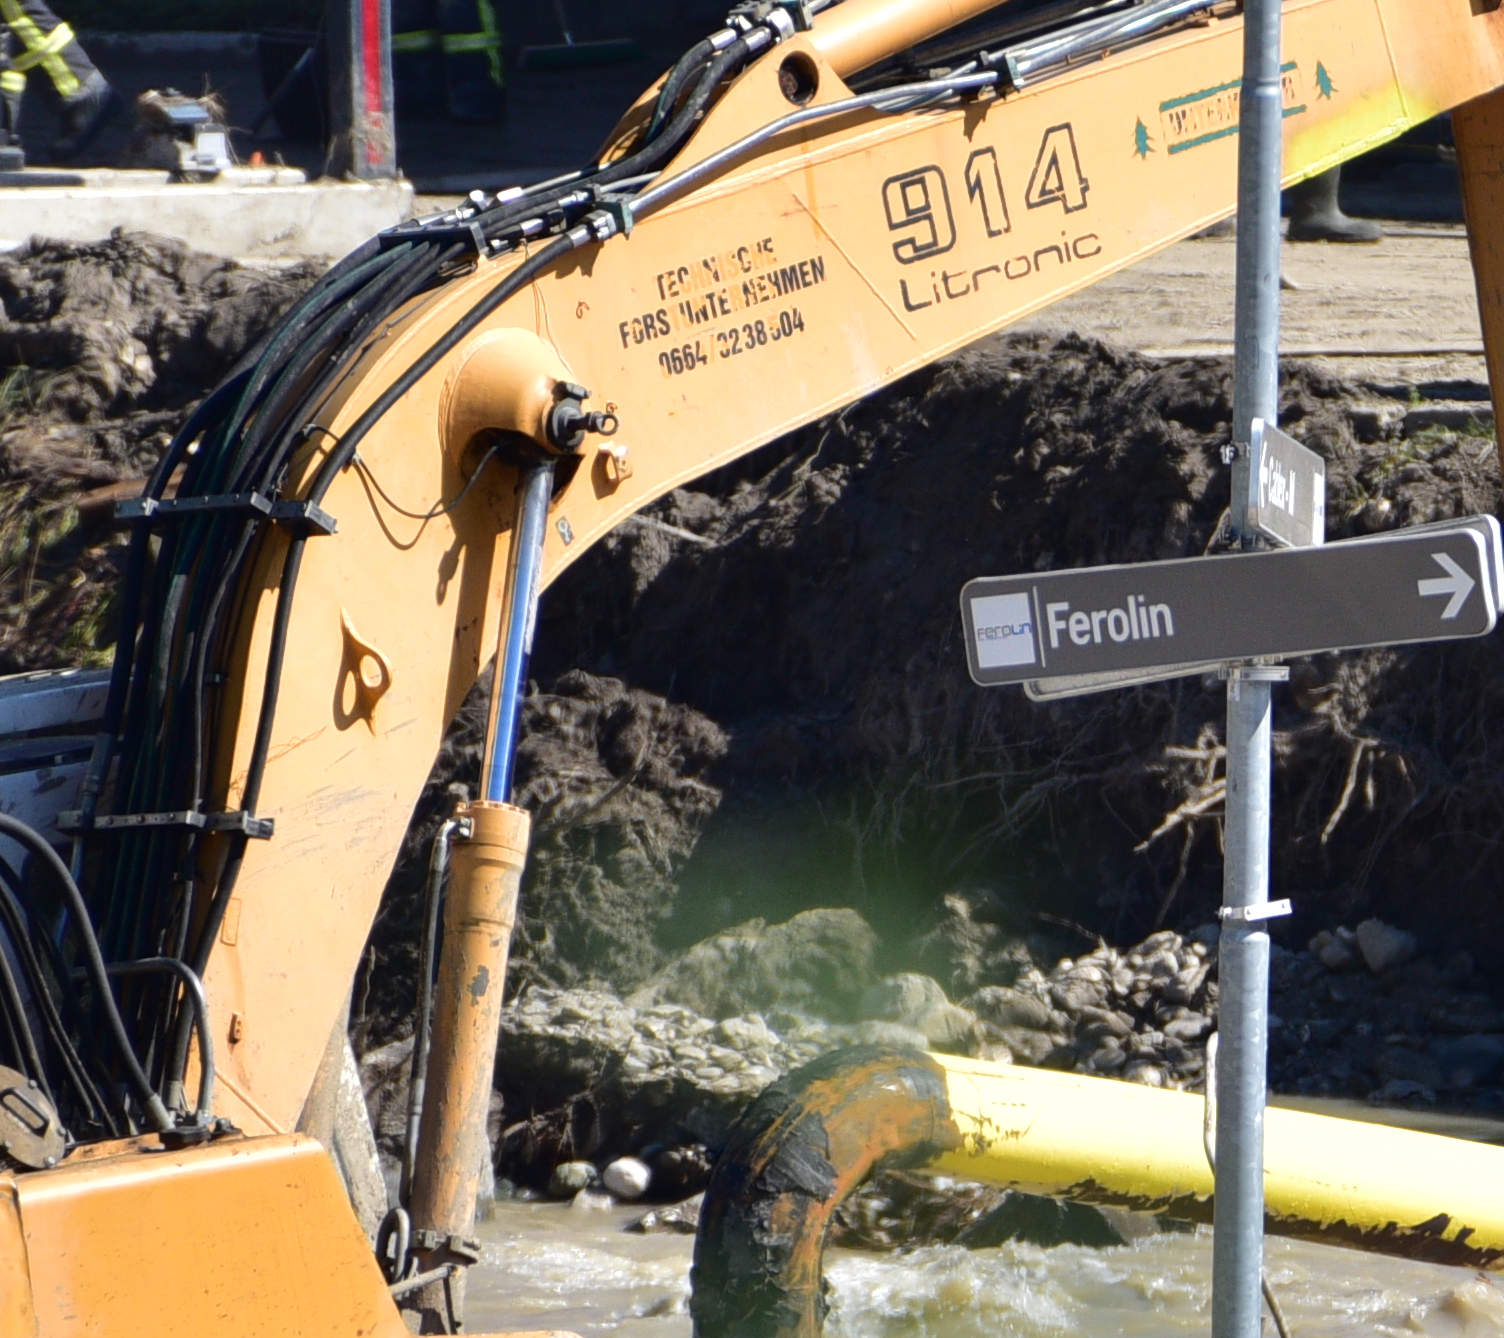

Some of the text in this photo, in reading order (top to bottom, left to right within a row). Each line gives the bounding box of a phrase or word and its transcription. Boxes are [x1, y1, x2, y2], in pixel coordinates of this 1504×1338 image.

[882, 121, 1091, 265] 914
[899, 230, 1102, 312] Litronic
[1046, 593, 1175, 649] Ferolin
